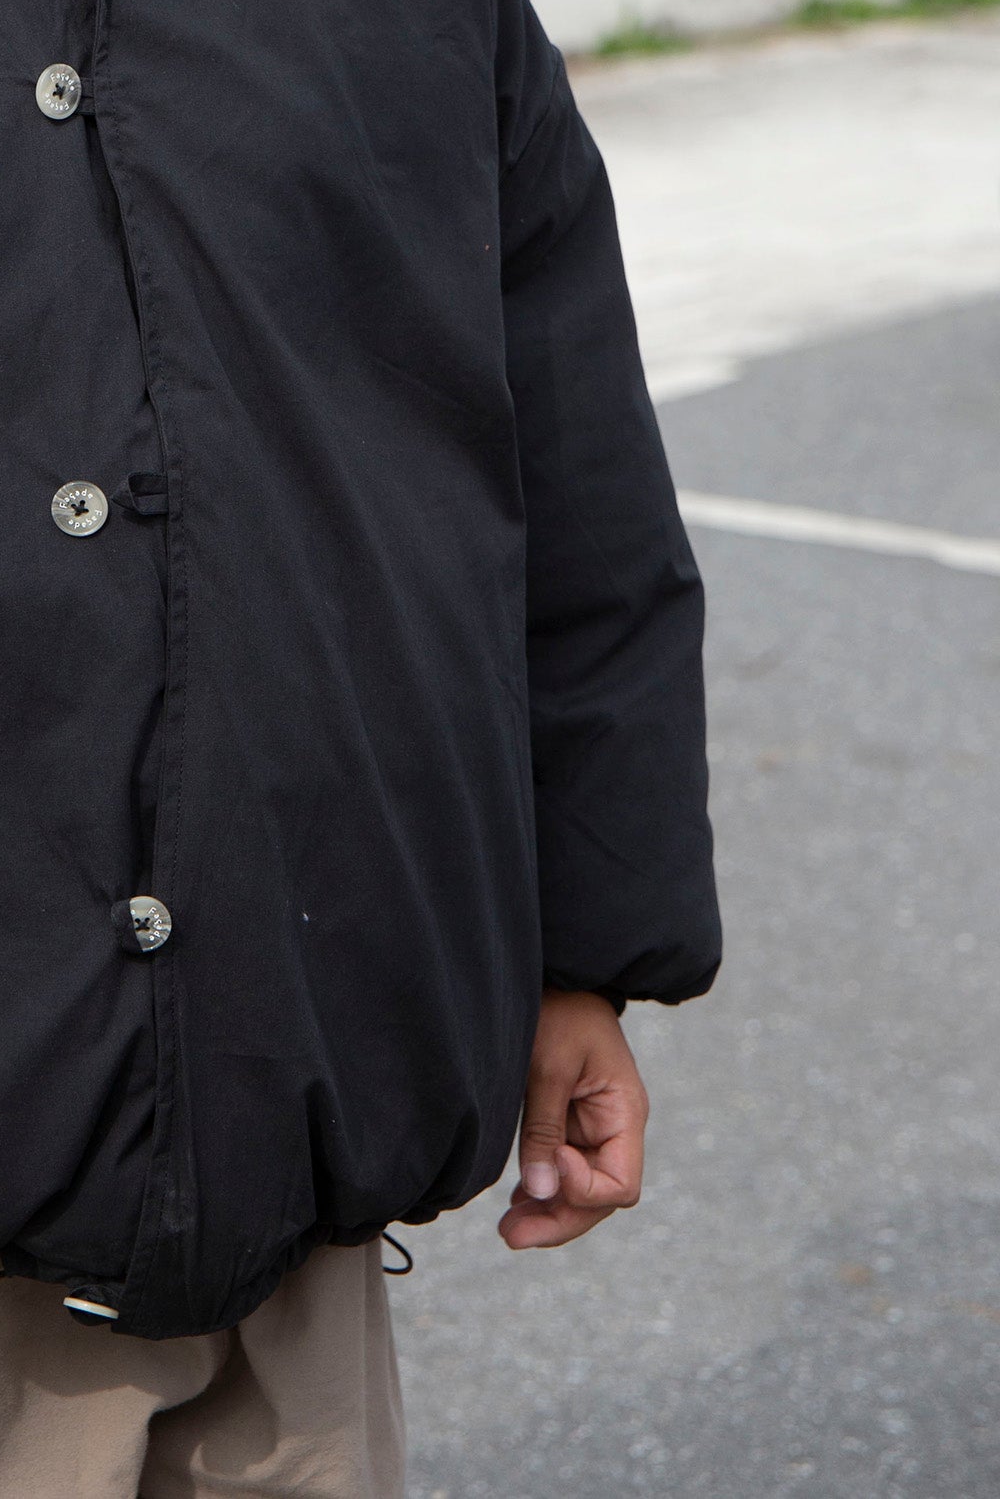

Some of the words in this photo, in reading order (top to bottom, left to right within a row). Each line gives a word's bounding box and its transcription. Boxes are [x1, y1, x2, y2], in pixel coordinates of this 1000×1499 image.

[49, 72, 75, 91] Façade
[59, 488, 94, 509] Façade
[68, 509, 103, 529] Façade
